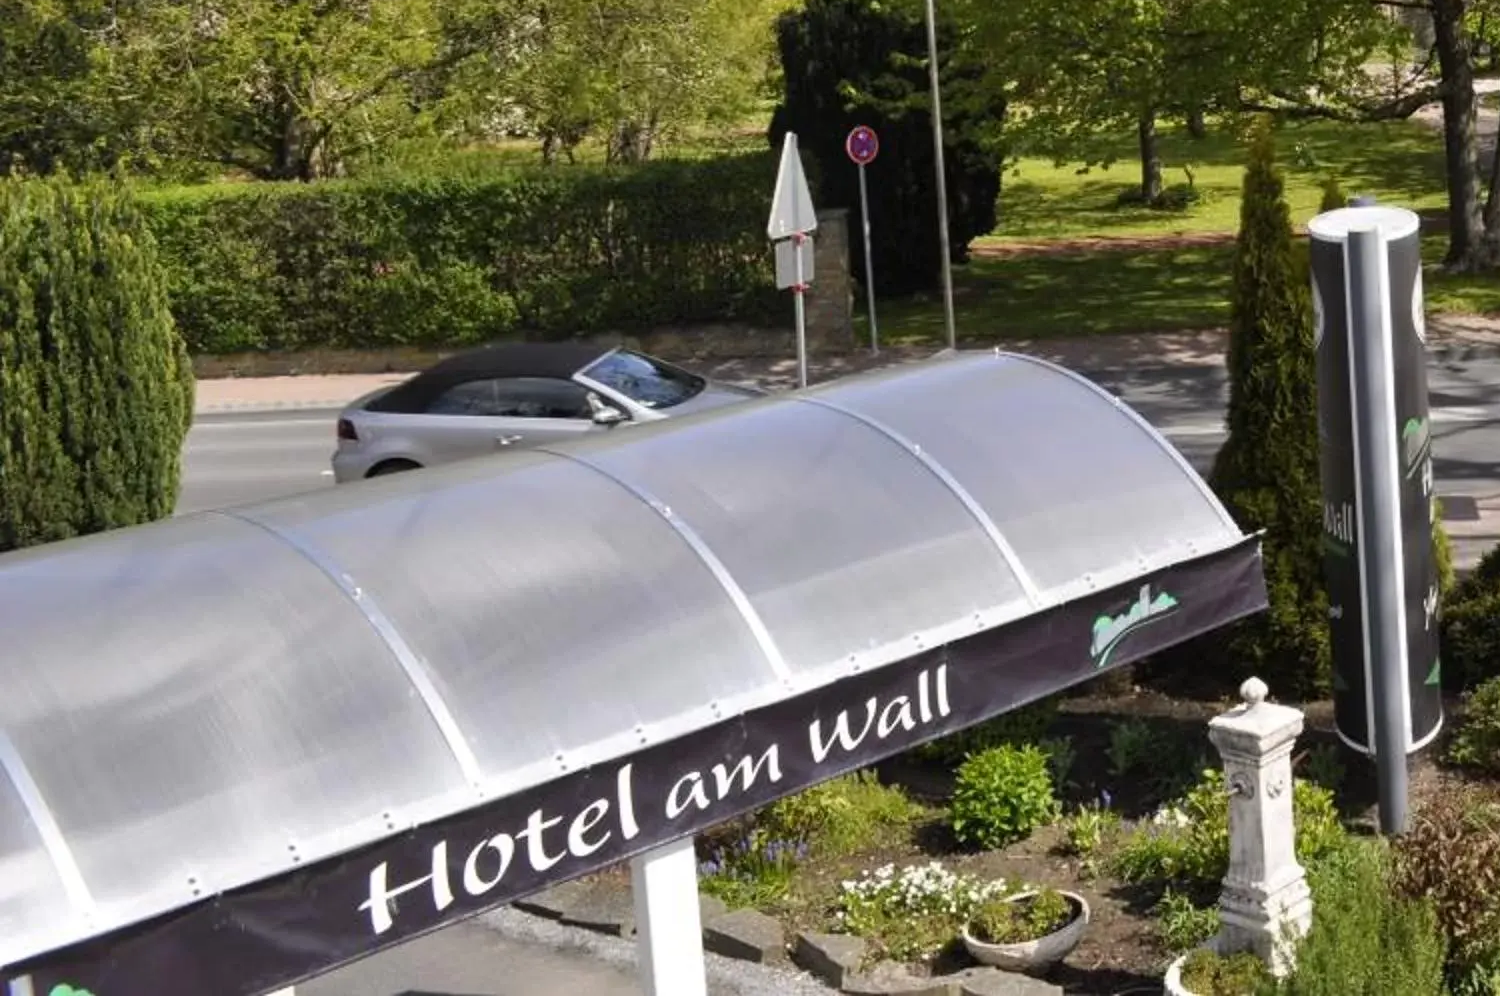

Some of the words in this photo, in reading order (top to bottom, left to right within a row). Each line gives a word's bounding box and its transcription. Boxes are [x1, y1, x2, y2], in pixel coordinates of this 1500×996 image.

[358, 763, 640, 935] Hotel
[664, 743, 783, 819] am
[809, 663, 951, 764] Wall
